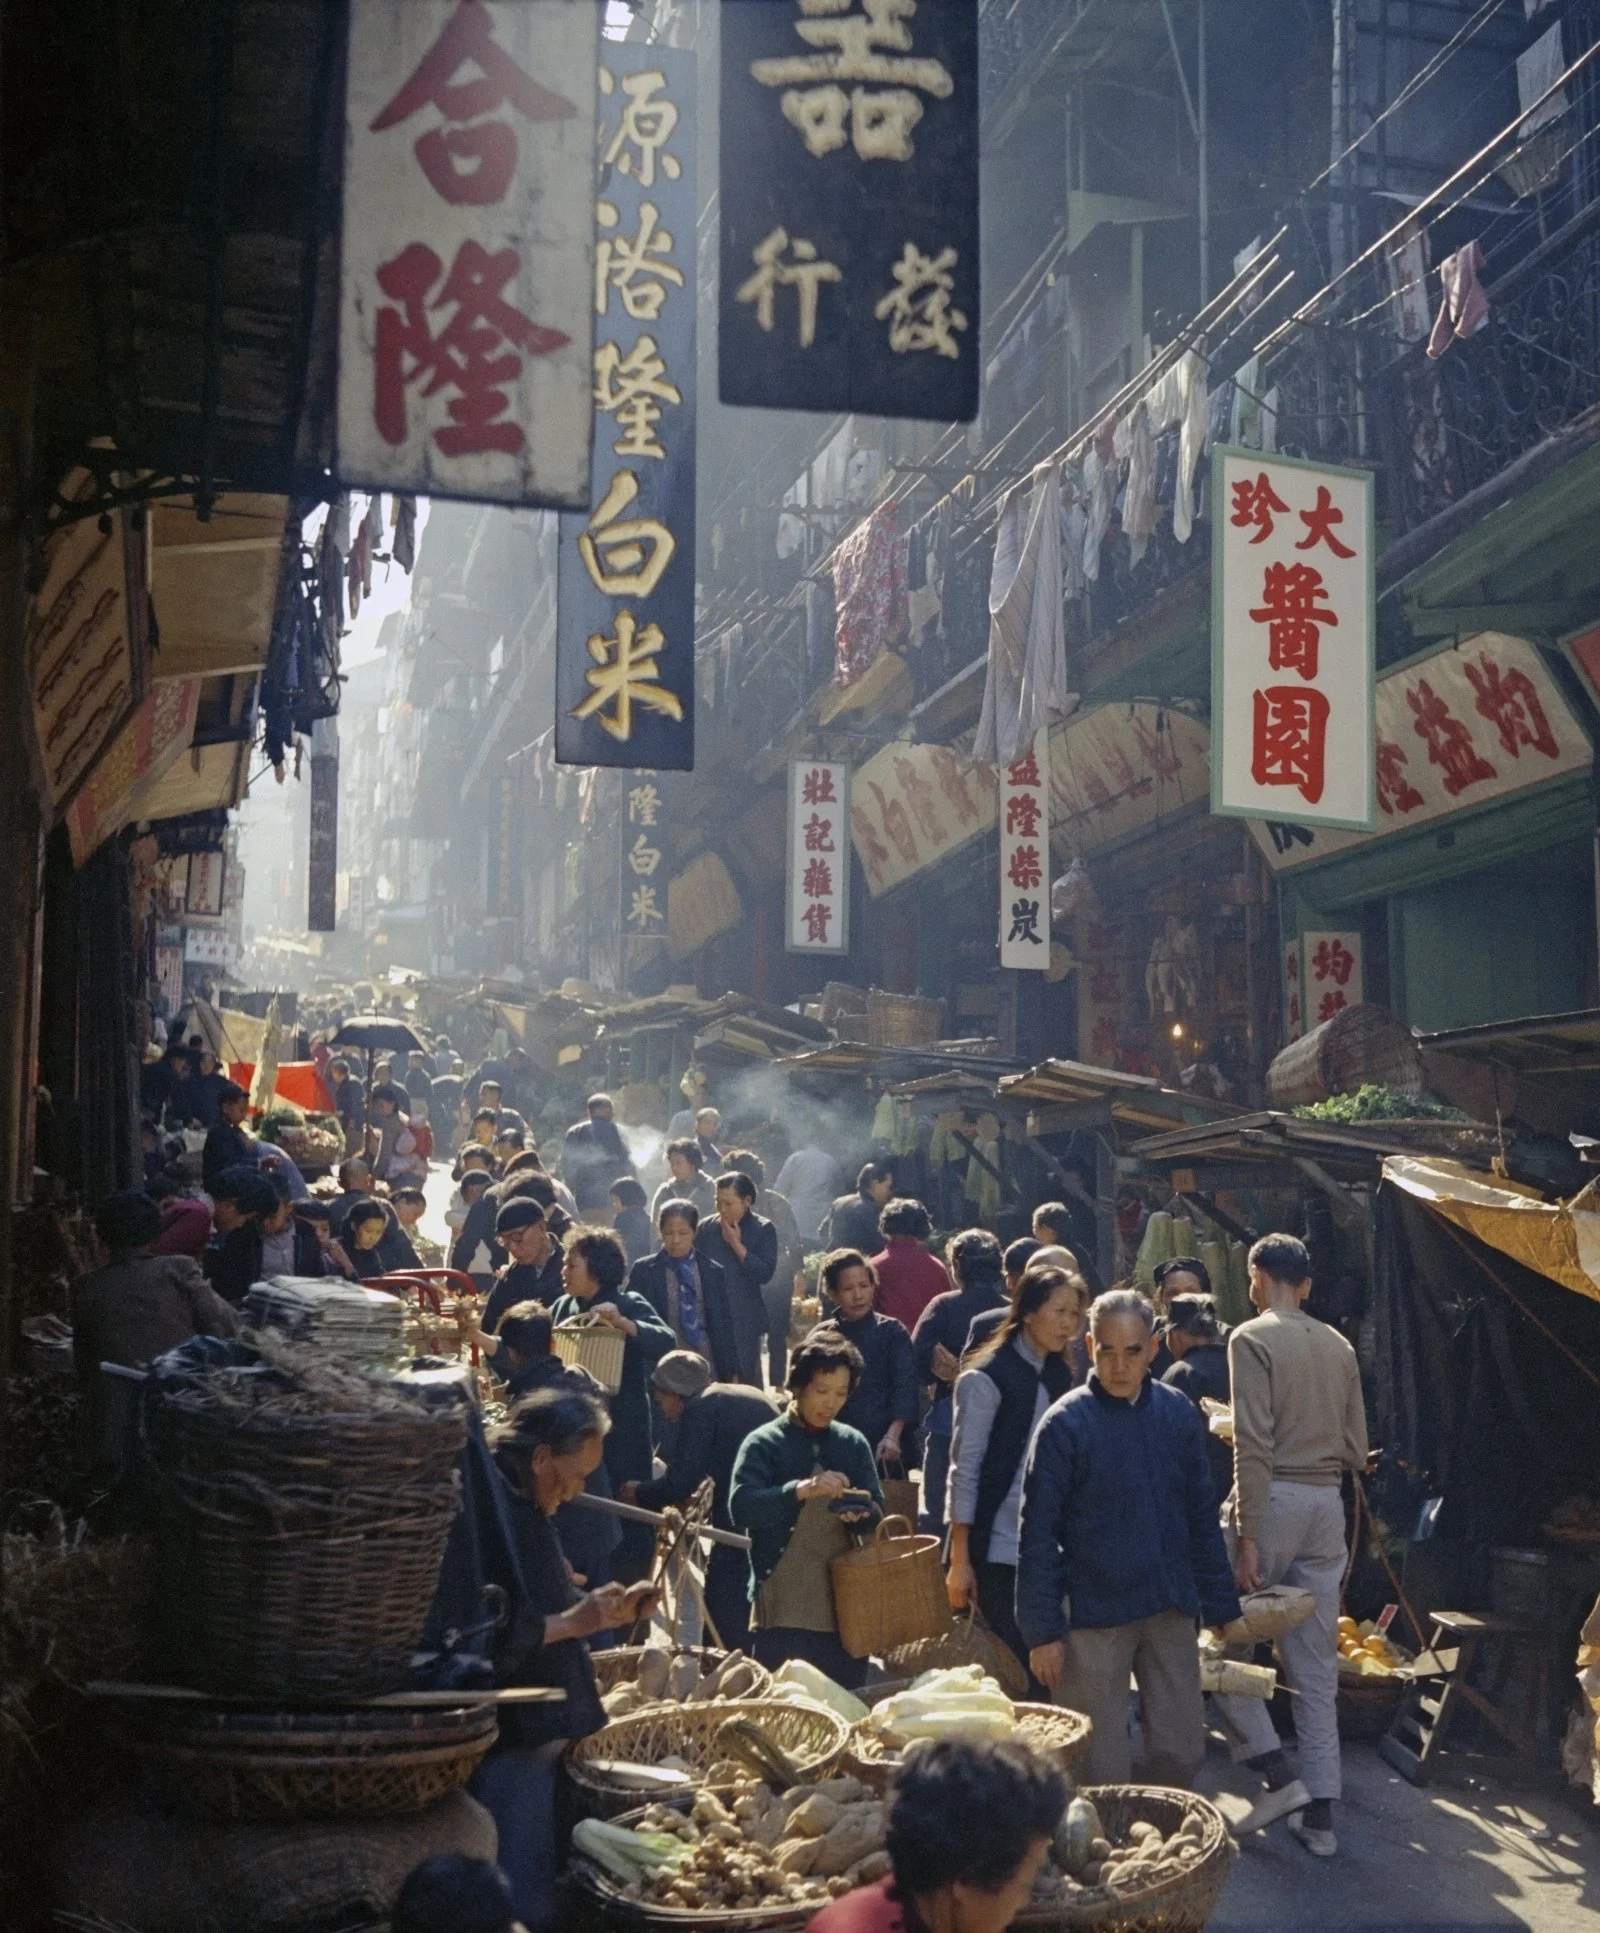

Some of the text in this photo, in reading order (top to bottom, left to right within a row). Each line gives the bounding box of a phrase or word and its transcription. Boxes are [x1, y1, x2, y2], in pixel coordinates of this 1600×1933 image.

[368, 0, 577, 457] 合隆
[627, 768, 664, 927] 隆白米
